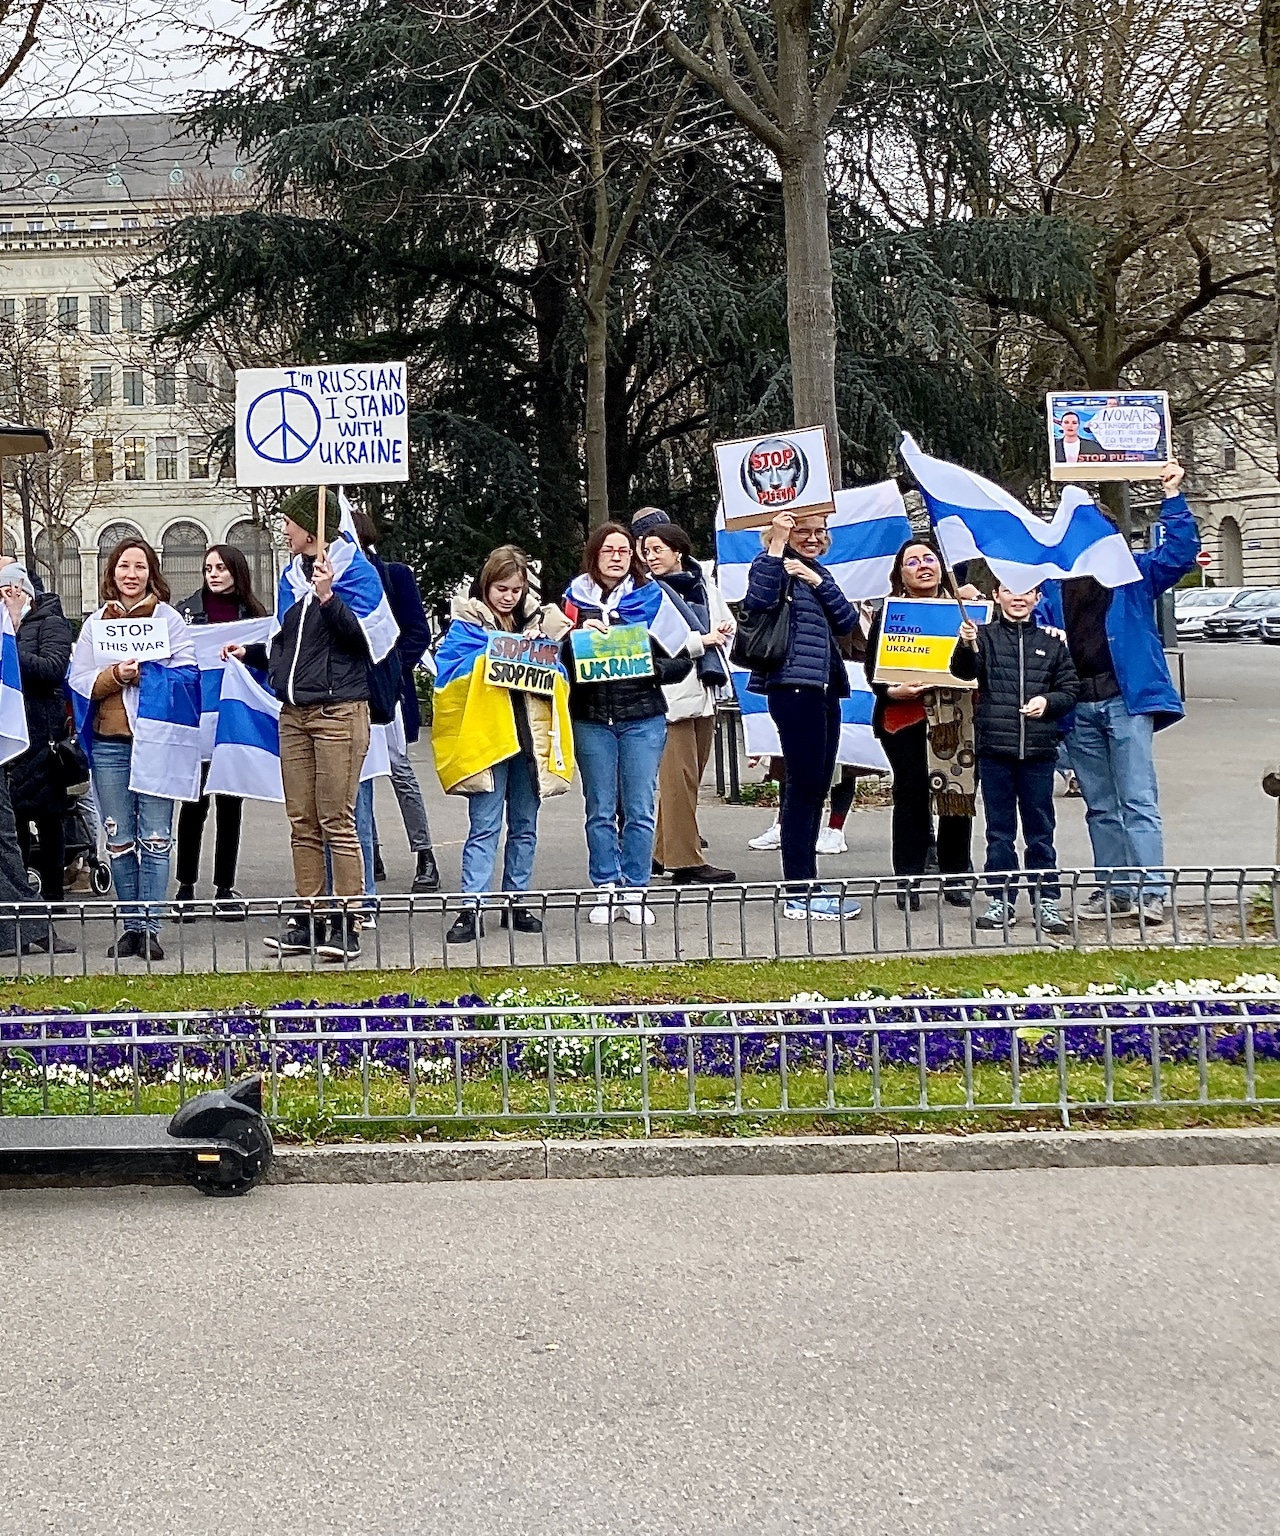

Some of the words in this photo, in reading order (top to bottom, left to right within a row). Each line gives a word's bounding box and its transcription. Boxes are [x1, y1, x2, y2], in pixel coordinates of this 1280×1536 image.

[284, 371, 313, 388] I'm
[317, 367, 402, 394] RUSSIAN
[325, 397, 341, 419] I
[345, 392, 406, 418] STAND
[338, 421, 383, 437] WITH
[319, 438, 402, 465] UKRAINE
[750, 448, 794, 470] STOP
[1078, 453, 1107, 462] STOP
[890, 614, 906, 622] WE
[106, 624, 153, 637] STOP
[888, 625, 922, 634] STAND
[98, 641, 128, 652] THIS
[132, 641, 165, 652] WAR
[887, 635, 915, 643] WITH
[490, 636, 530, 660] STOP
[886, 645, 931, 655] UKRAINE
[489, 662, 525, 685] STOP
[580, 655, 652, 680] UKRAINE
